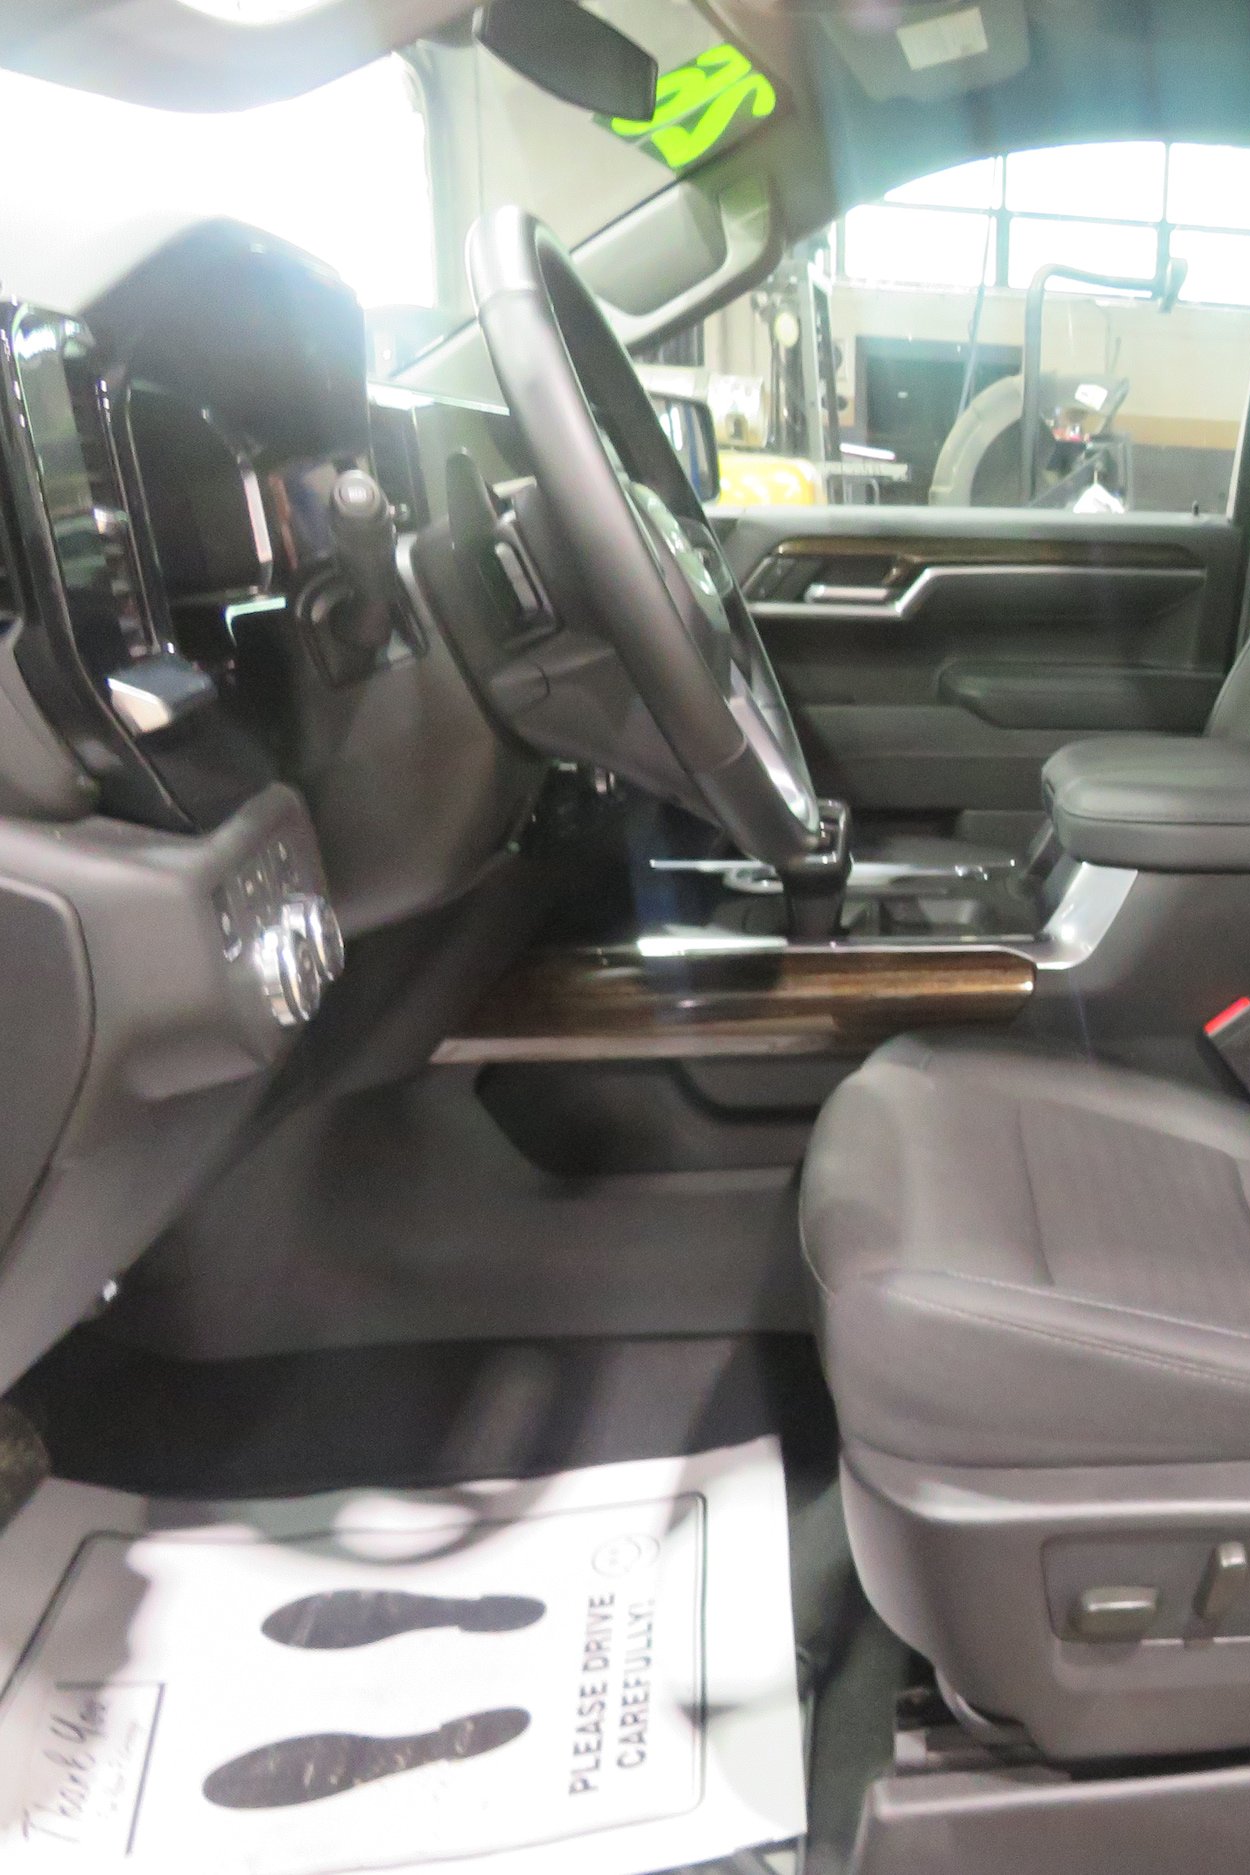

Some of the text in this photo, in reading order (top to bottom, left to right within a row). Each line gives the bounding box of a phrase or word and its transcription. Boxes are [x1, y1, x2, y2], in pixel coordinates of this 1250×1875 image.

[569, 1593, 615, 1796] PLEASE DRIVE
[616, 1598, 656, 1769] CAREFULLY!
